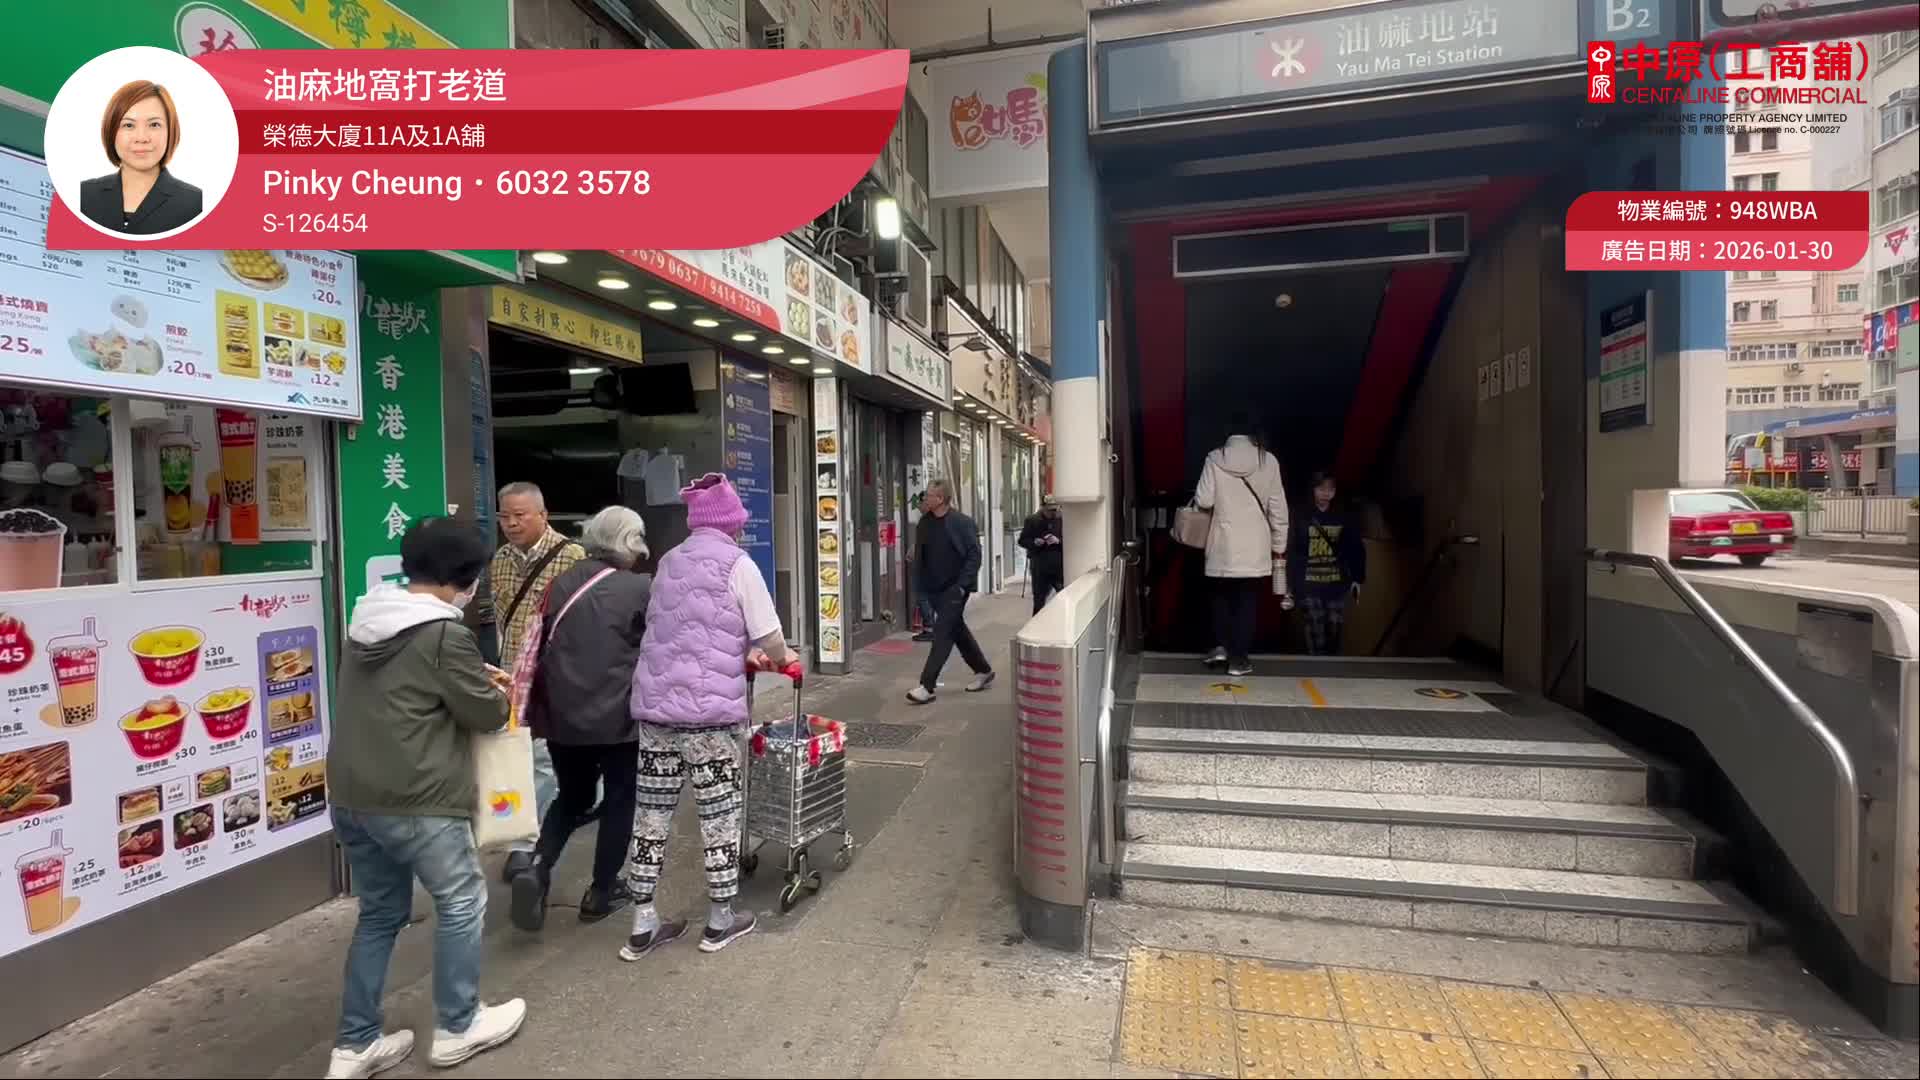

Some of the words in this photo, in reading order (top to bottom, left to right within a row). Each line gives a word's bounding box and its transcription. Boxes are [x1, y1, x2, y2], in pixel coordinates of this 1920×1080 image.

[1336, 4, 1498, 56] 油麻地站
[1606, 0, 1651, 32] B2
[1336, 63, 1369, 78] Yau
[1375, 58, 1400, 73] Ma
[1406, 52, 1432, 68] Tei
[1437, 45, 1503, 65] Station
[668, 257, 699, 285] 0637
[711, 279, 736, 304] 9414
[373, 354, 411, 541] 香港美食
[204, 646, 225, 658] $30
[8, 683, 49, 697] 珍珠奶茶
[239, 729, 258, 742] $40
[175, 745, 197, 760] $30
